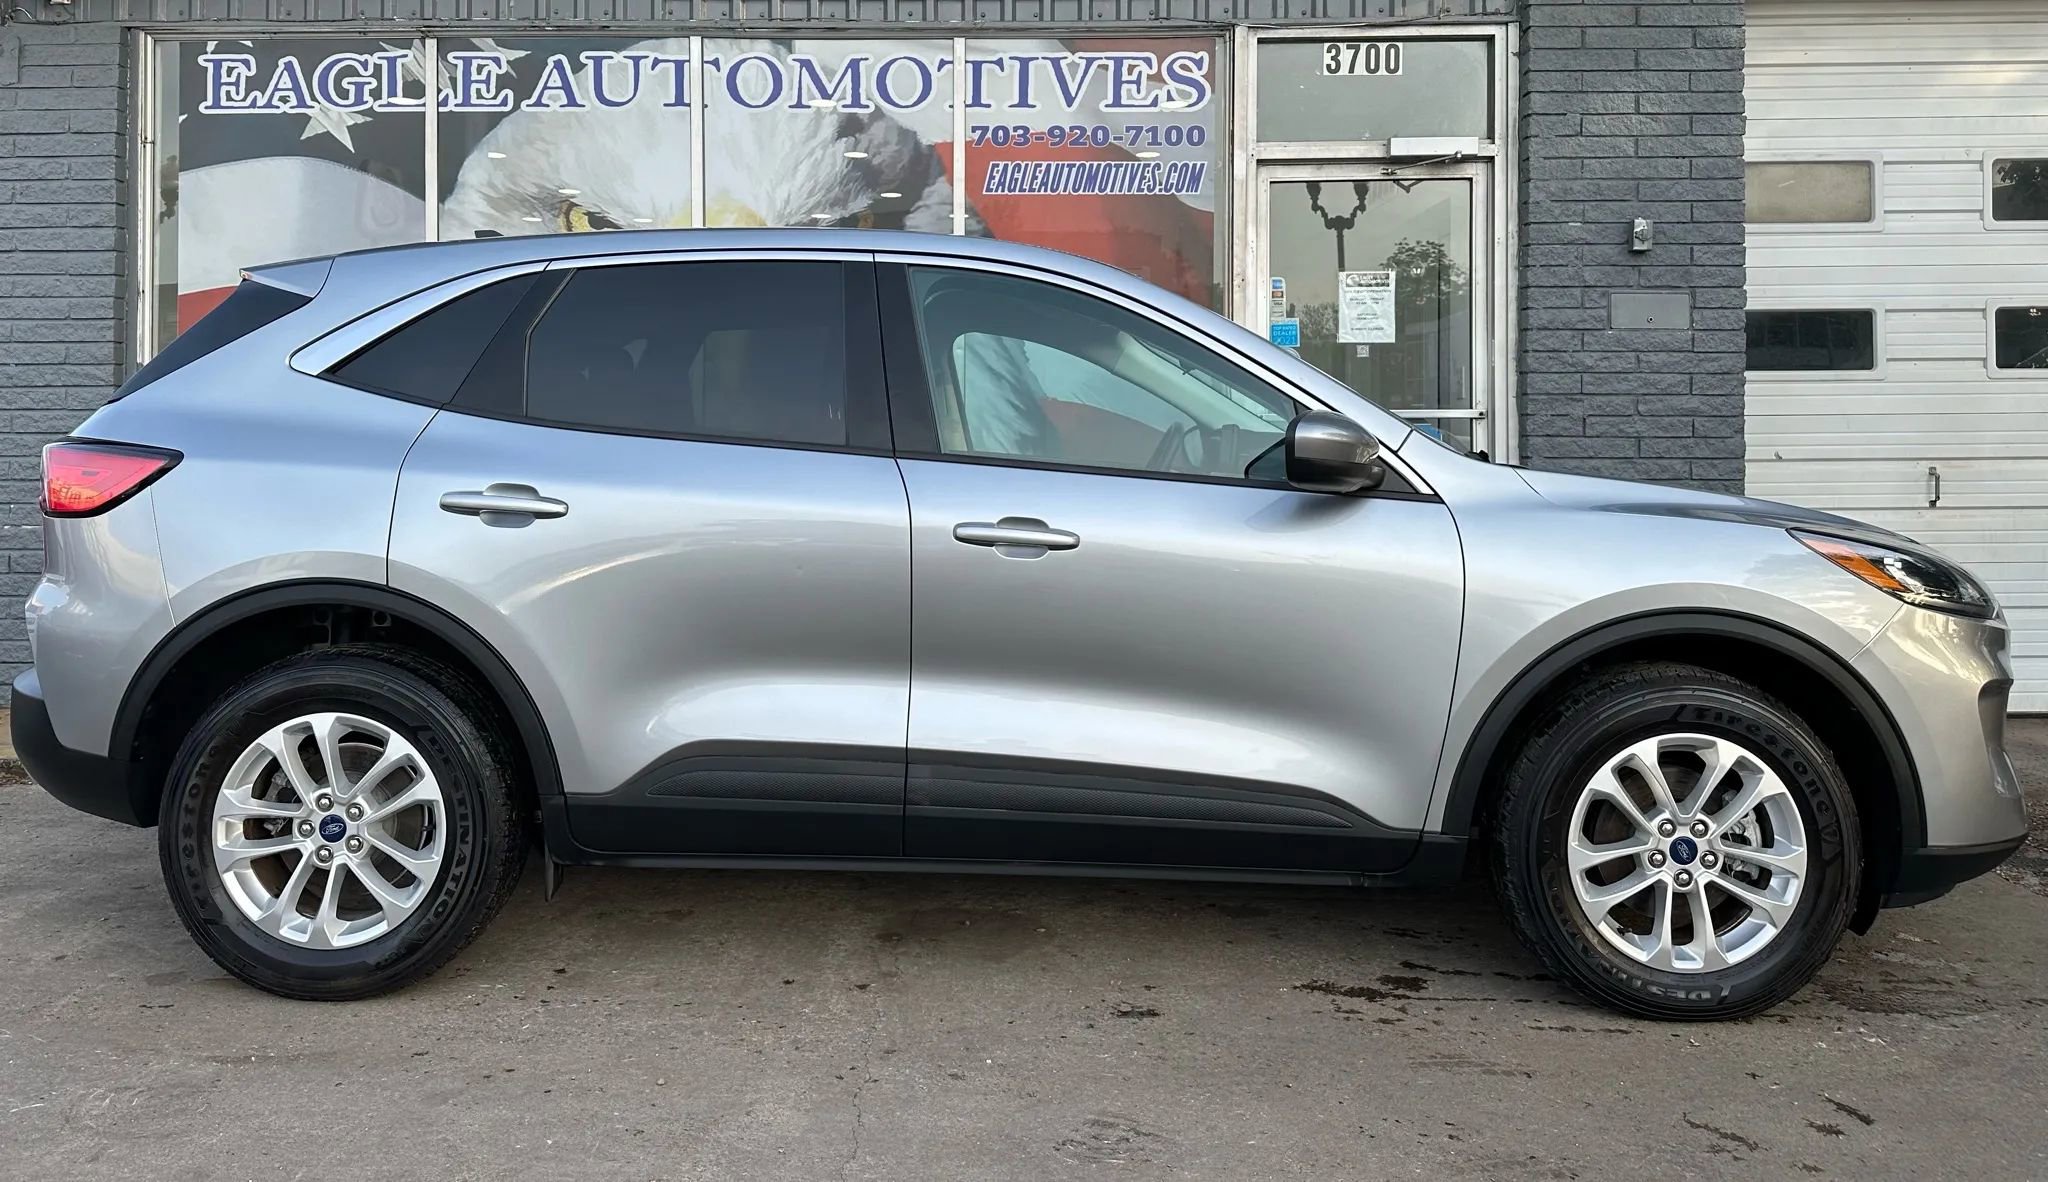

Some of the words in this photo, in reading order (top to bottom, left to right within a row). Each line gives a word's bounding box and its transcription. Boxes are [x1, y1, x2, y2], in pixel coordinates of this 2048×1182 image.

[1325, 43, 1400, 74] 3700
[198, 52, 514, 114] EAGLE
[520, 50, 1212, 113] AUTOMOTIVES
[970, 124, 1206, 148] 703-920-7100
[983, 161, 1207, 195] EAGLEAUTOMOTIVES.COM
